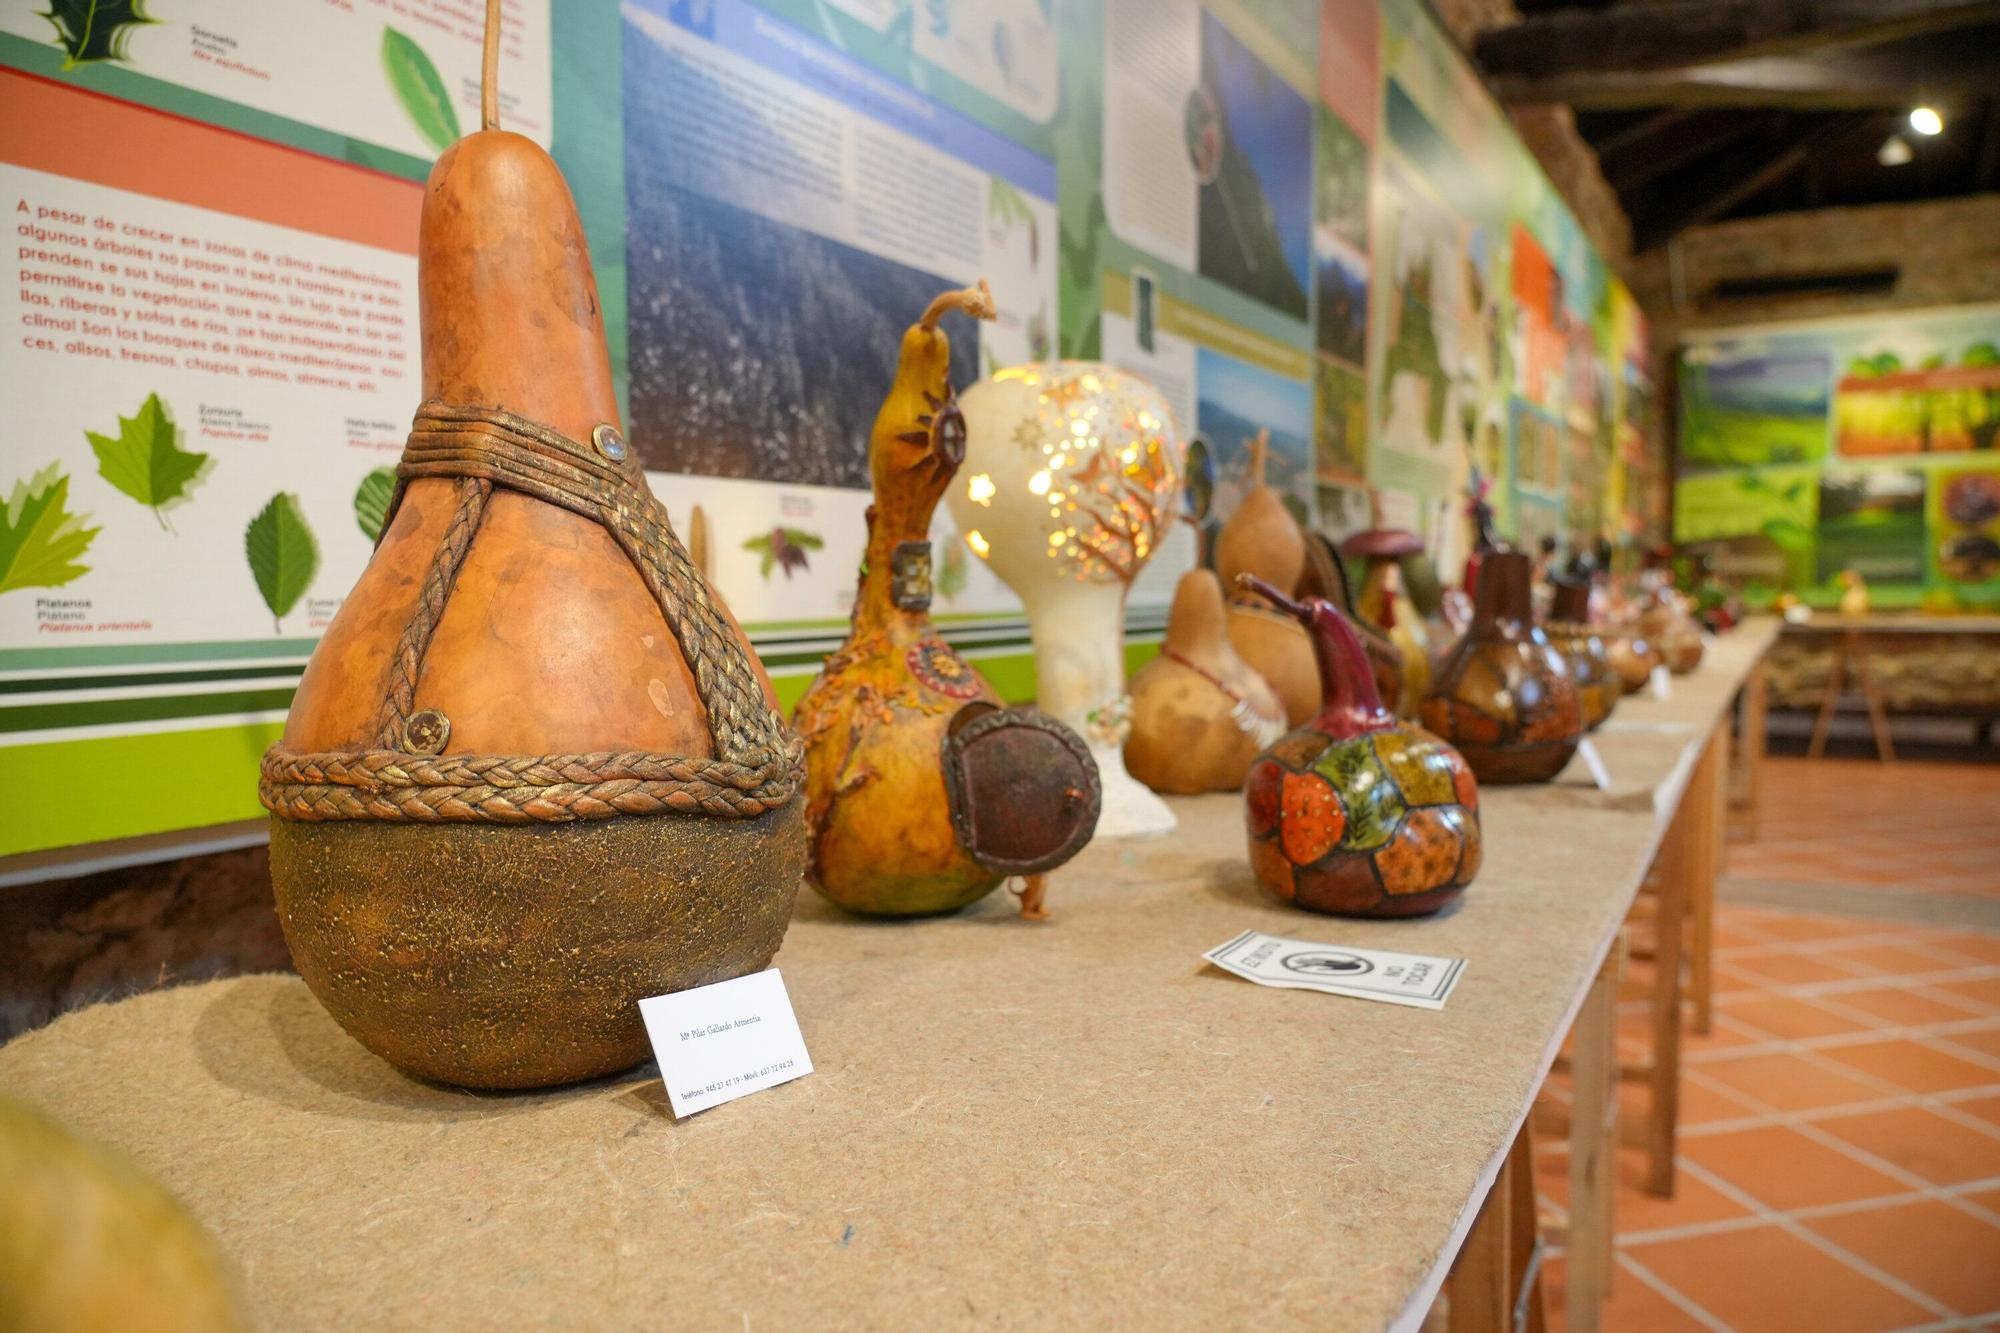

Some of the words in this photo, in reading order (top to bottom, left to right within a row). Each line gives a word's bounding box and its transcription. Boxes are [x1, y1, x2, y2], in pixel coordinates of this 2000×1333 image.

[17, 199, 30, 213] A
[37, 205, 86, 225] pesar
[94, 216, 115, 231] de
[122, 223, 174, 243] crecer
[180, 236, 200, 249] en
[252, 250, 270, 264] de
[18, 223, 88, 248] algunos
[94, 236, 153, 260] árboles
[159, 251, 179, 265] no
[19, 247, 94, 270] prenden
[100, 262, 118, 274] se
[124, 266, 148, 281] sus
[154, 269, 196, 291] hojas
[201, 279, 220, 292] en
[19, 268, 105, 295] permitirse
[111, 282, 126, 298] la
[133, 289, 220, 313] vegetación
[224, 303, 251, 319] que
[20, 289, 55, 309] llas,
[59, 295, 118, 318] riberas
[122, 309, 132, 321] y
[136, 311, 176, 328] sotos
[180, 315, 200, 330] de
[21, 312, 76, 333] clima!
[82, 319, 112, 338] Son
[116, 325, 138, 341] los
[143, 329, 207, 352] bosques
[212, 341, 230, 355] de
[23, 335, 59, 353] ces,
[65, 341, 116, 360] alisos,
[120, 347, 181, 369] fresnos,
[691, 1028, 706, 1039] Pilar
[707, 1021, 733, 1035] Gallardo
[734, 1015, 761, 1028] Armentia
[705, 1082, 717, 1093] 945
